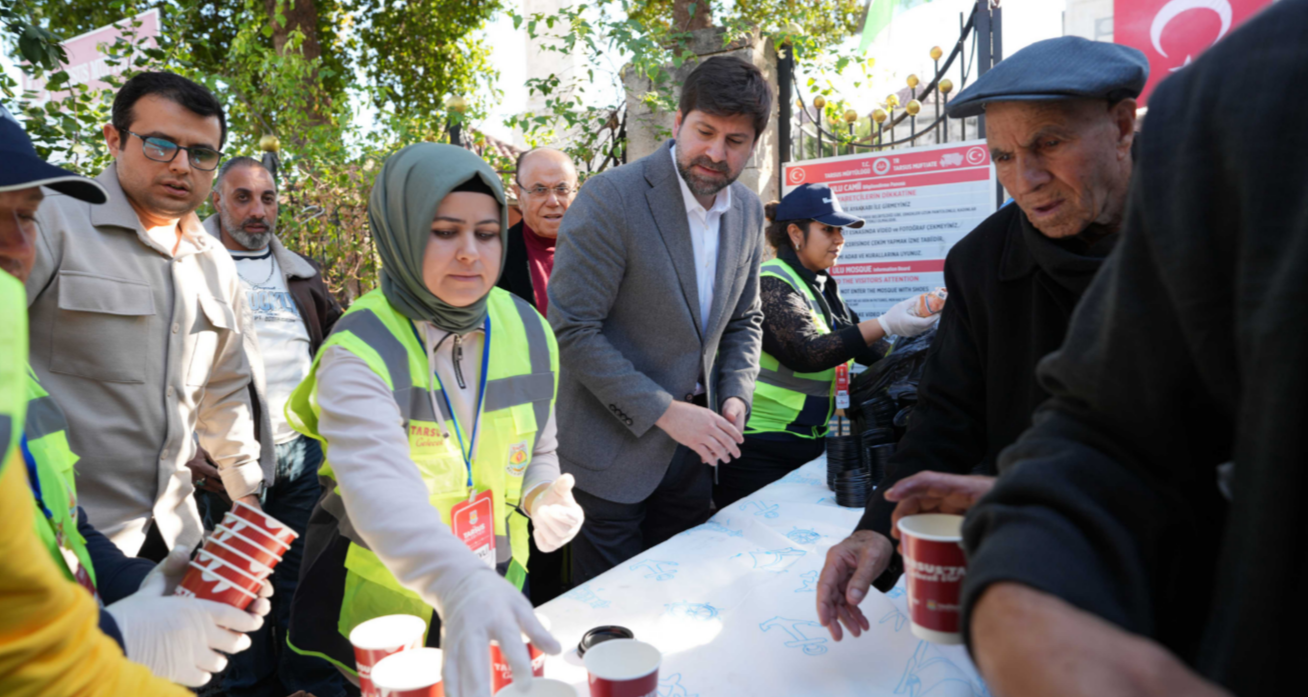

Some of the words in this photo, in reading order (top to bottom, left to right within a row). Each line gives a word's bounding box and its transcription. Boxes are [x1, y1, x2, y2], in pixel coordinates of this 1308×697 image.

[832, 266, 844, 274] ULU
[845, 265, 872, 273] MOSQUE
[855, 276, 882, 284] VISITORS
[884, 275, 919, 283] ATTENTION
[411, 425, 441, 437] TARSU
